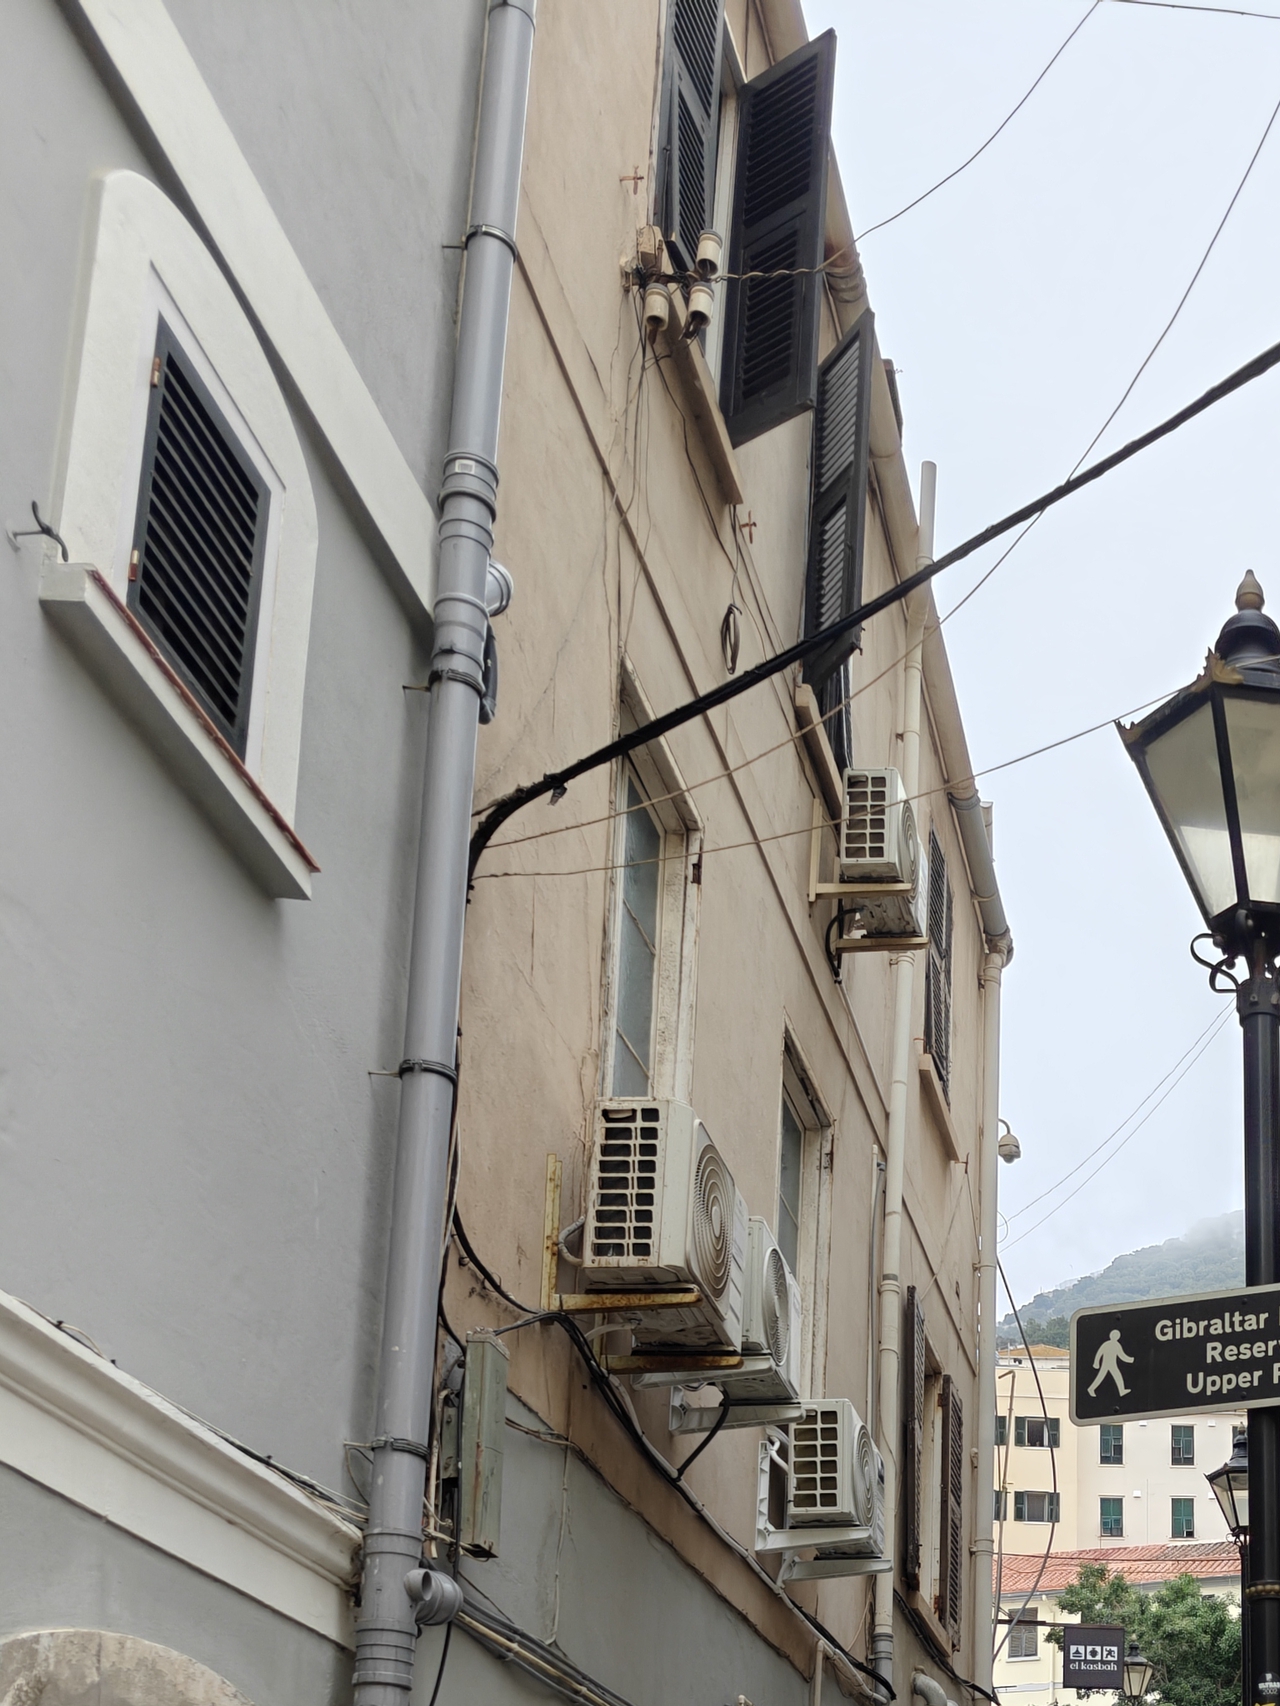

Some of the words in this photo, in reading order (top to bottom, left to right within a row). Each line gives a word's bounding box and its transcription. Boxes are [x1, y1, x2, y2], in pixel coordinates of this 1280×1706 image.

[1154, 1310, 1269, 1342] Gibraltar
[1186, 1370, 1263, 1396] Upper
[1070, 1661, 1079, 1670] el
[1081, 1661, 1118, 1671] kasbah
